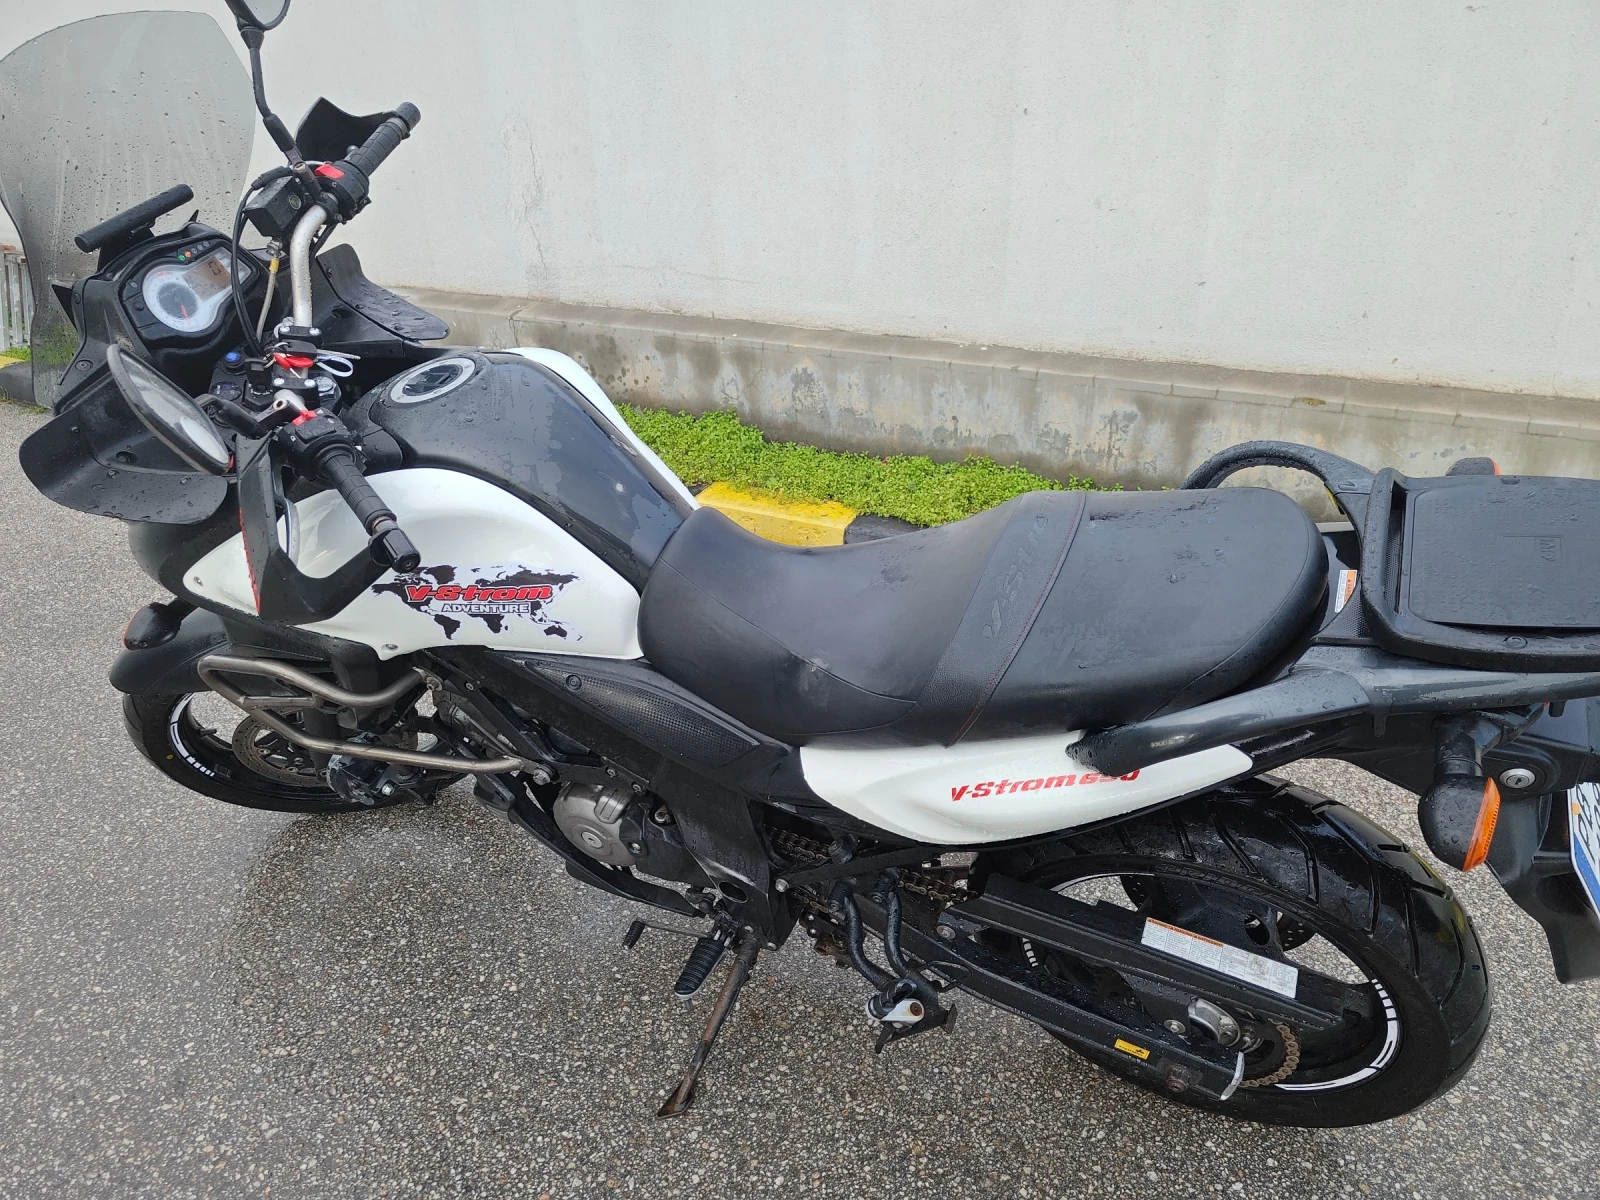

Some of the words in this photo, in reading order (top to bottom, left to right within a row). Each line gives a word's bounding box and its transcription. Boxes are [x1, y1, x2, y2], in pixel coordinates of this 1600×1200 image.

[406, 585, 553, 602] V-Strom
[442, 604, 530, 613] ADVENTURE
[951, 774, 1077, 802] V-Strom
